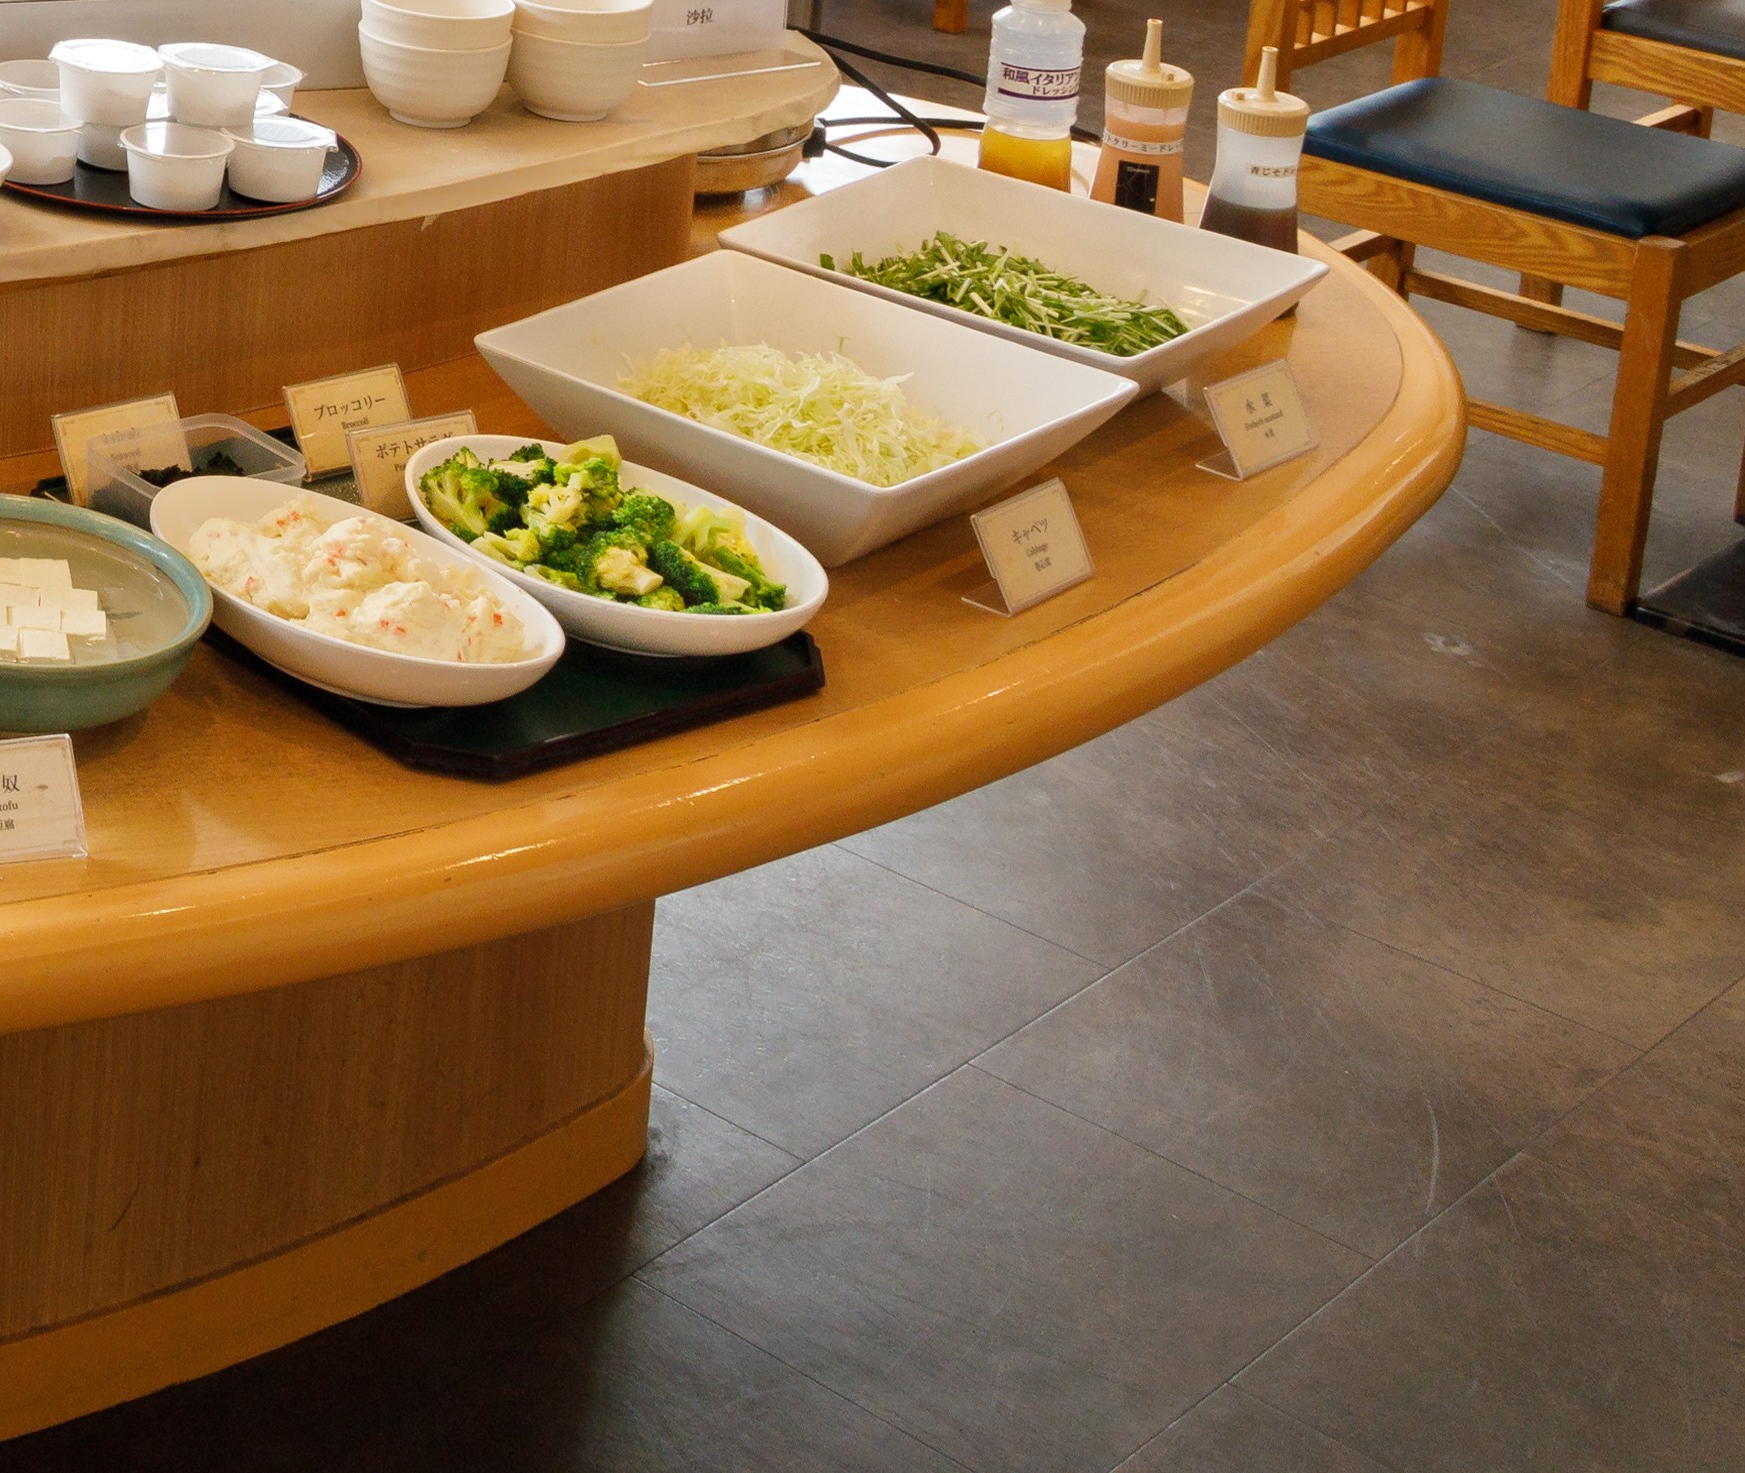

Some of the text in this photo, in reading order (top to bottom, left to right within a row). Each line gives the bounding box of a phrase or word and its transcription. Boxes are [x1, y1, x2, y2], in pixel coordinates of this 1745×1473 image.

[686, 8, 714, 26] 沙拉
[313, 394, 387, 421] ブロッコリー
[341, 417, 370, 430] Broccoli
[1012, 517, 1048, 545] キャベツ
